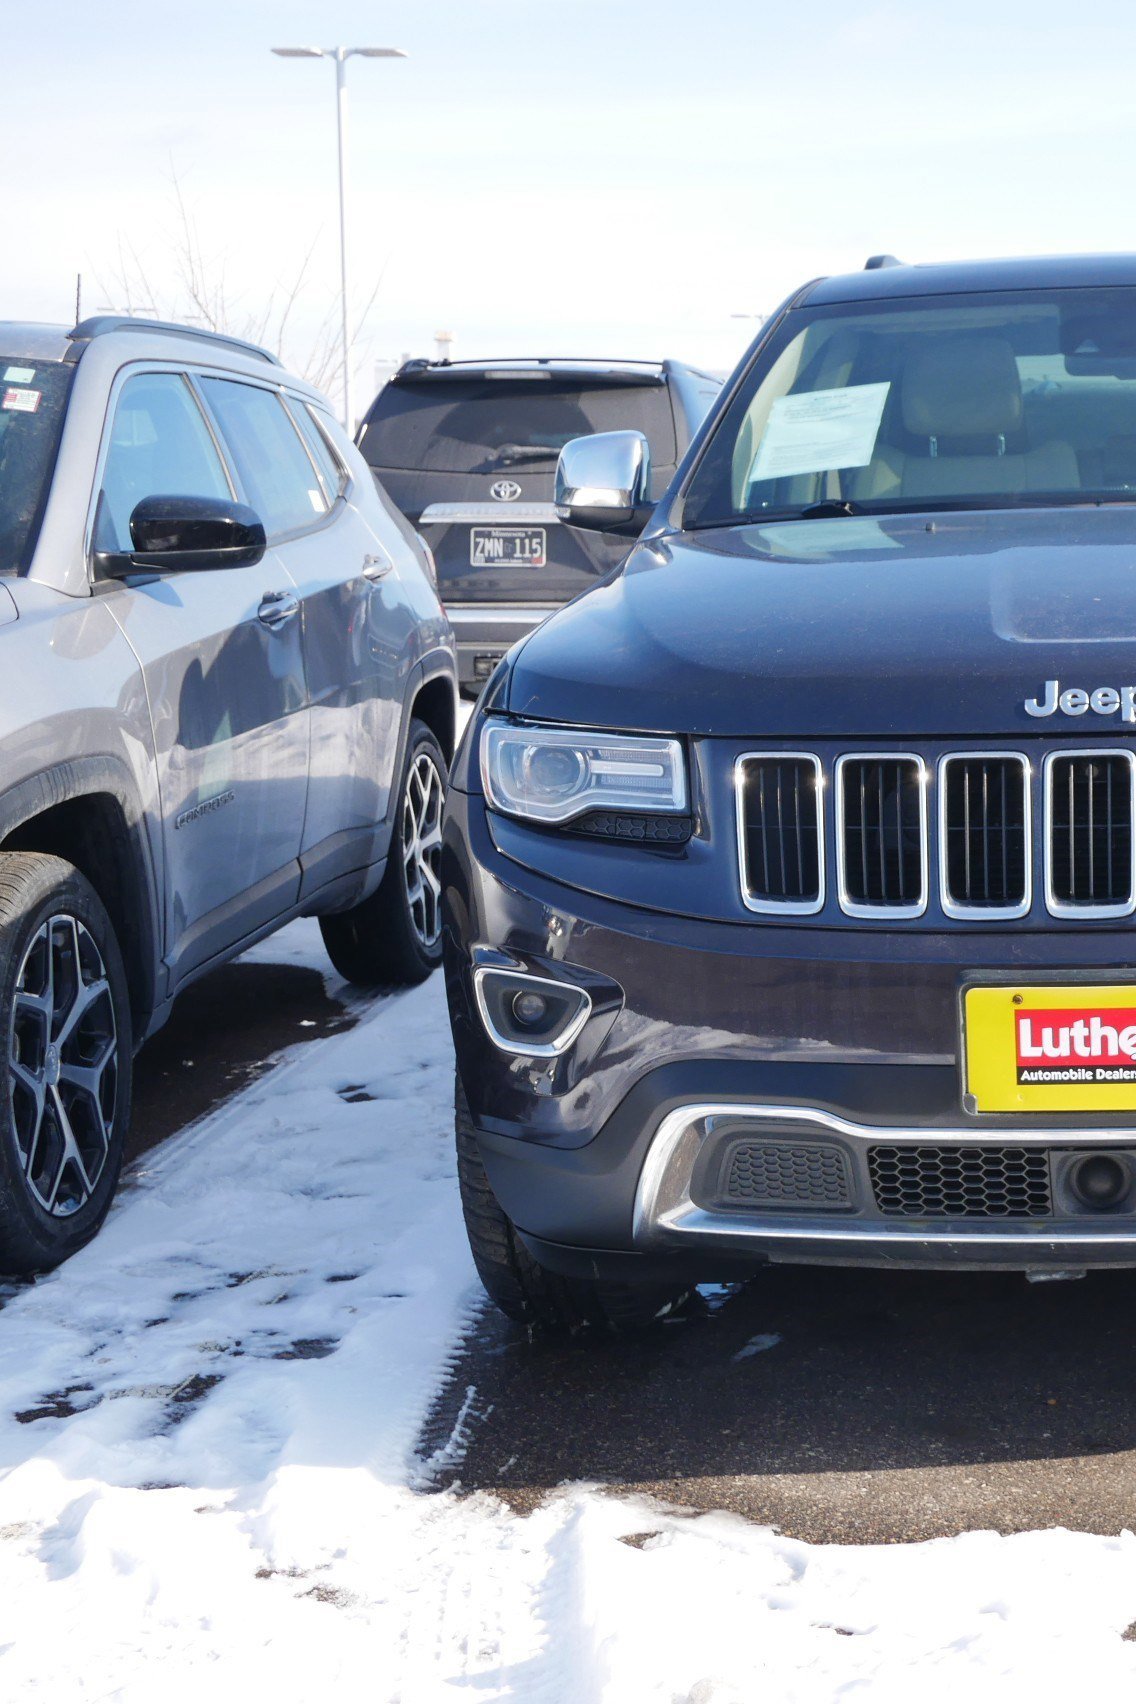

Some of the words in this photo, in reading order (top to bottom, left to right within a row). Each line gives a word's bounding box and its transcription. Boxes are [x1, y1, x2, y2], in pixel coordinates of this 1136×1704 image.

[474, 537, 504, 558] ZMN
[513, 537, 542, 558] 115
[1020, 1068, 1094, 1082] Automobile
